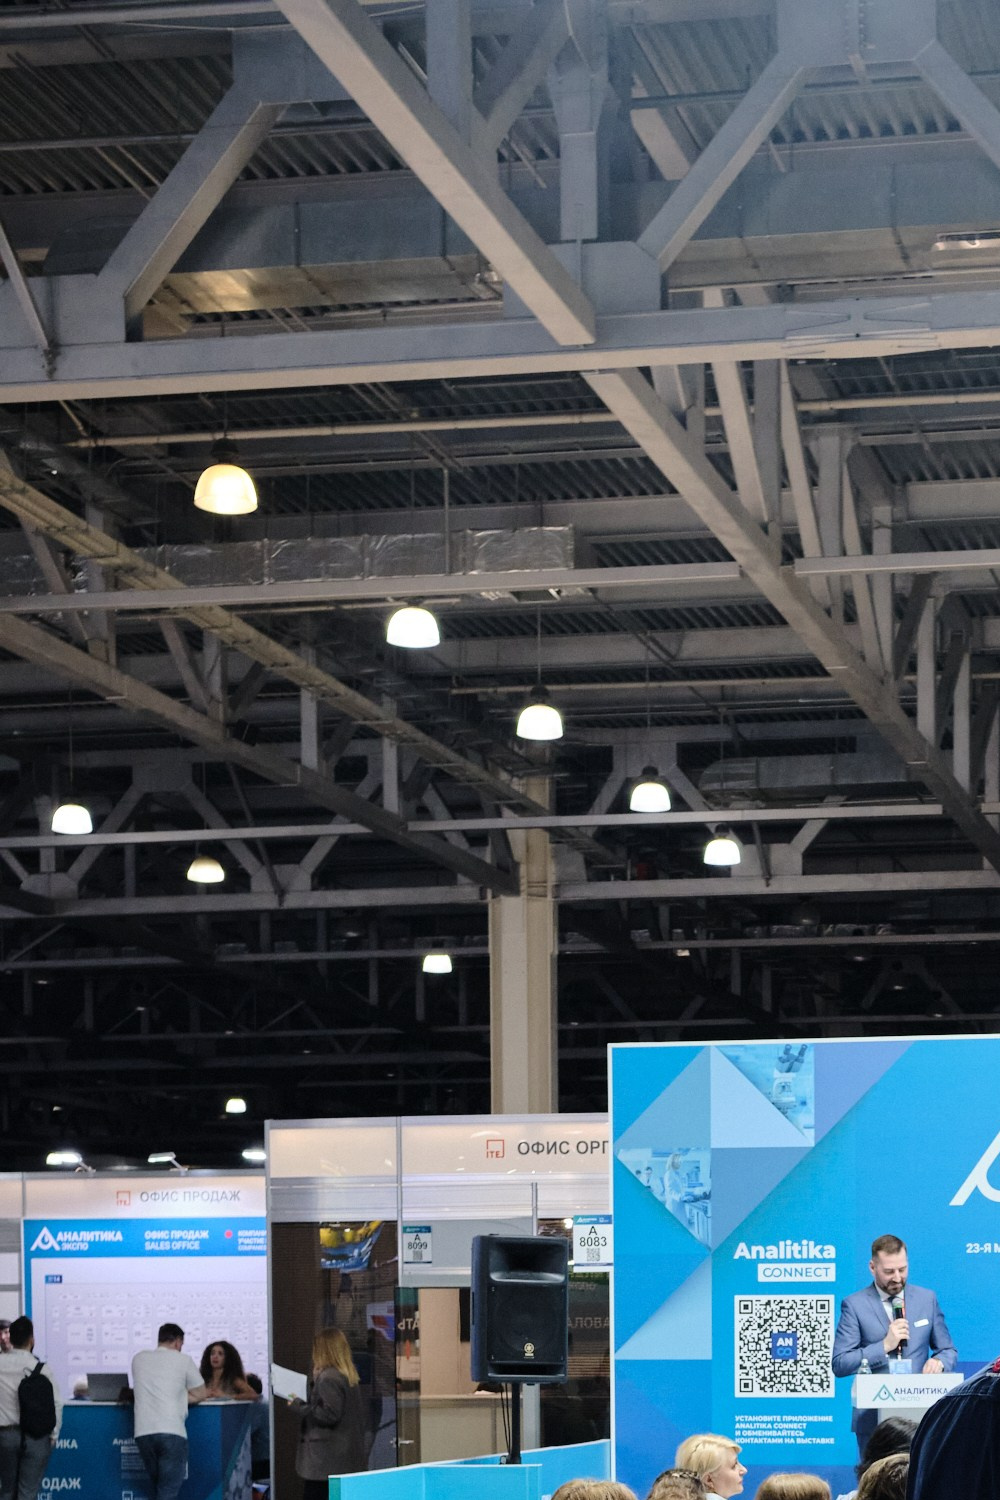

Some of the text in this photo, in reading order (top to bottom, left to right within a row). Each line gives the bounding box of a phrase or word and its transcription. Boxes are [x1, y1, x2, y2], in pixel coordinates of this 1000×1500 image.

[518, 1141, 570, 1155] ОФИС
[140, 1190, 241, 1203] ОФИС ПРОДАЖ
[56, 1230, 123, 1242] АНАЛИТИКА
[145, 1230, 209, 1240] ОФИС ПРОДАЖ
[145, 1240, 200, 1250] SALES OFFICE
[407, 1242, 428, 1250] 8099
[579, 1237, 607, 1247] 8083
[733, 1240, 836, 1260] Analitika
[966, 1243, 991, 1254] 23-Я
[763, 1266, 830, 1278] CONNECT
[777, 1337, 793, 1346] AN
